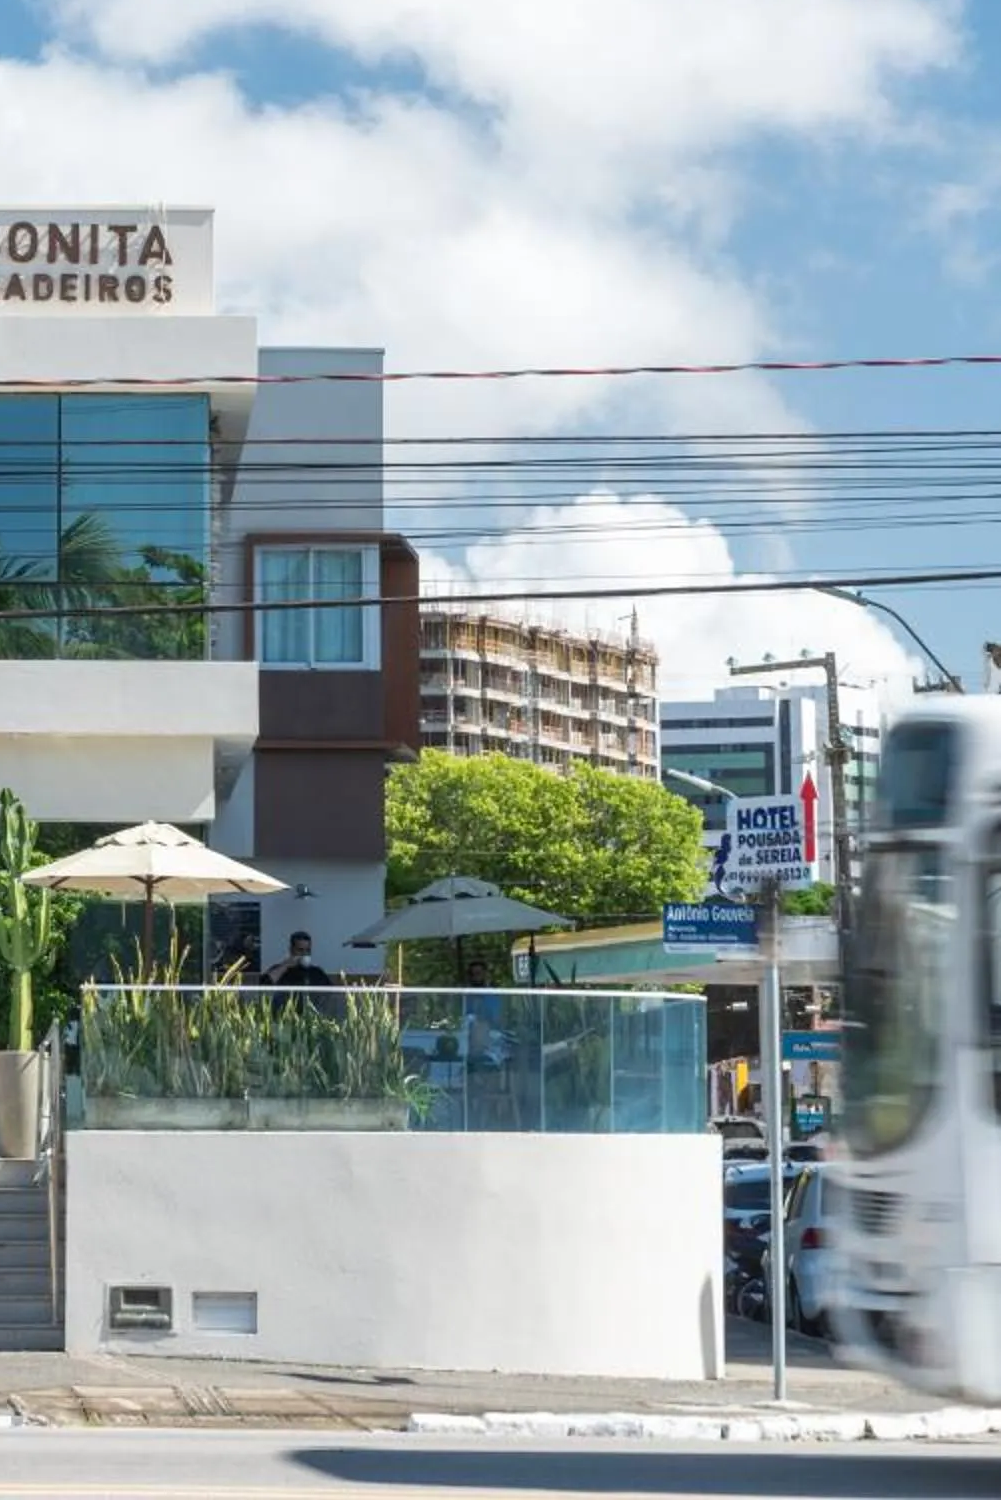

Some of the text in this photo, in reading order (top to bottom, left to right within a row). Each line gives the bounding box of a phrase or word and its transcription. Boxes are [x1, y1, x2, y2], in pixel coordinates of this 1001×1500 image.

[737, 805, 797, 830] HOTEL
[738, 830, 801, 849] POUSADA
[756, 847, 801, 864] SEREIA
